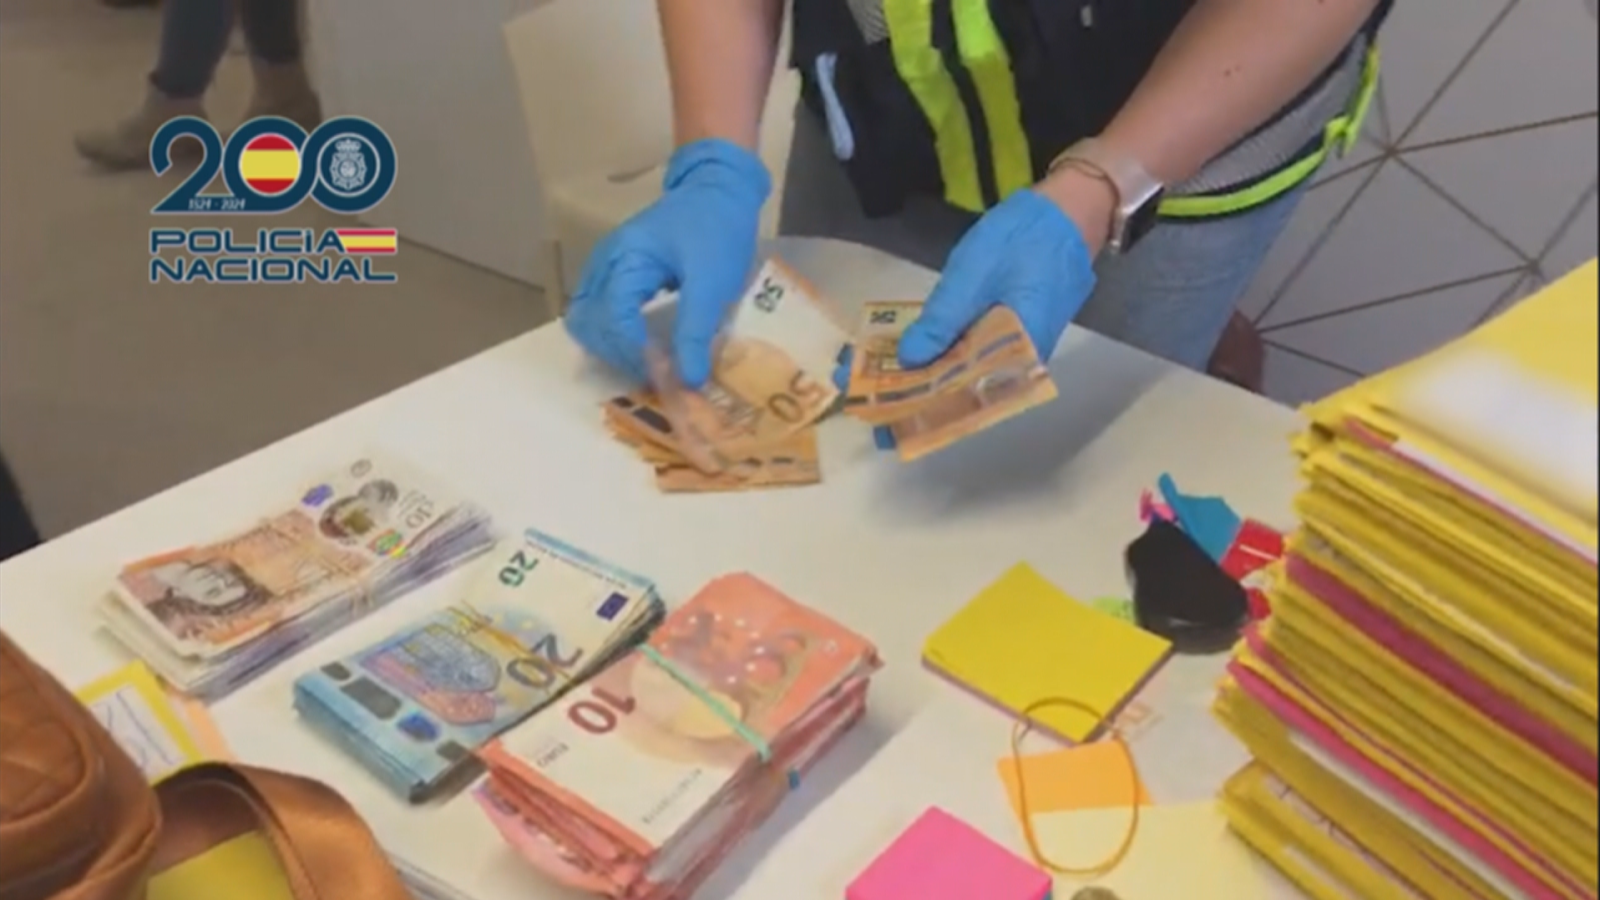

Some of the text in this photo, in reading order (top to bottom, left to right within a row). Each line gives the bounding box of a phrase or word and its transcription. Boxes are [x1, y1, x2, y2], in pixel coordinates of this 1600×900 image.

[498, 550, 539, 587] 20
[506, 632, 584, 688] 20
[567, 686, 636, 734] 10
